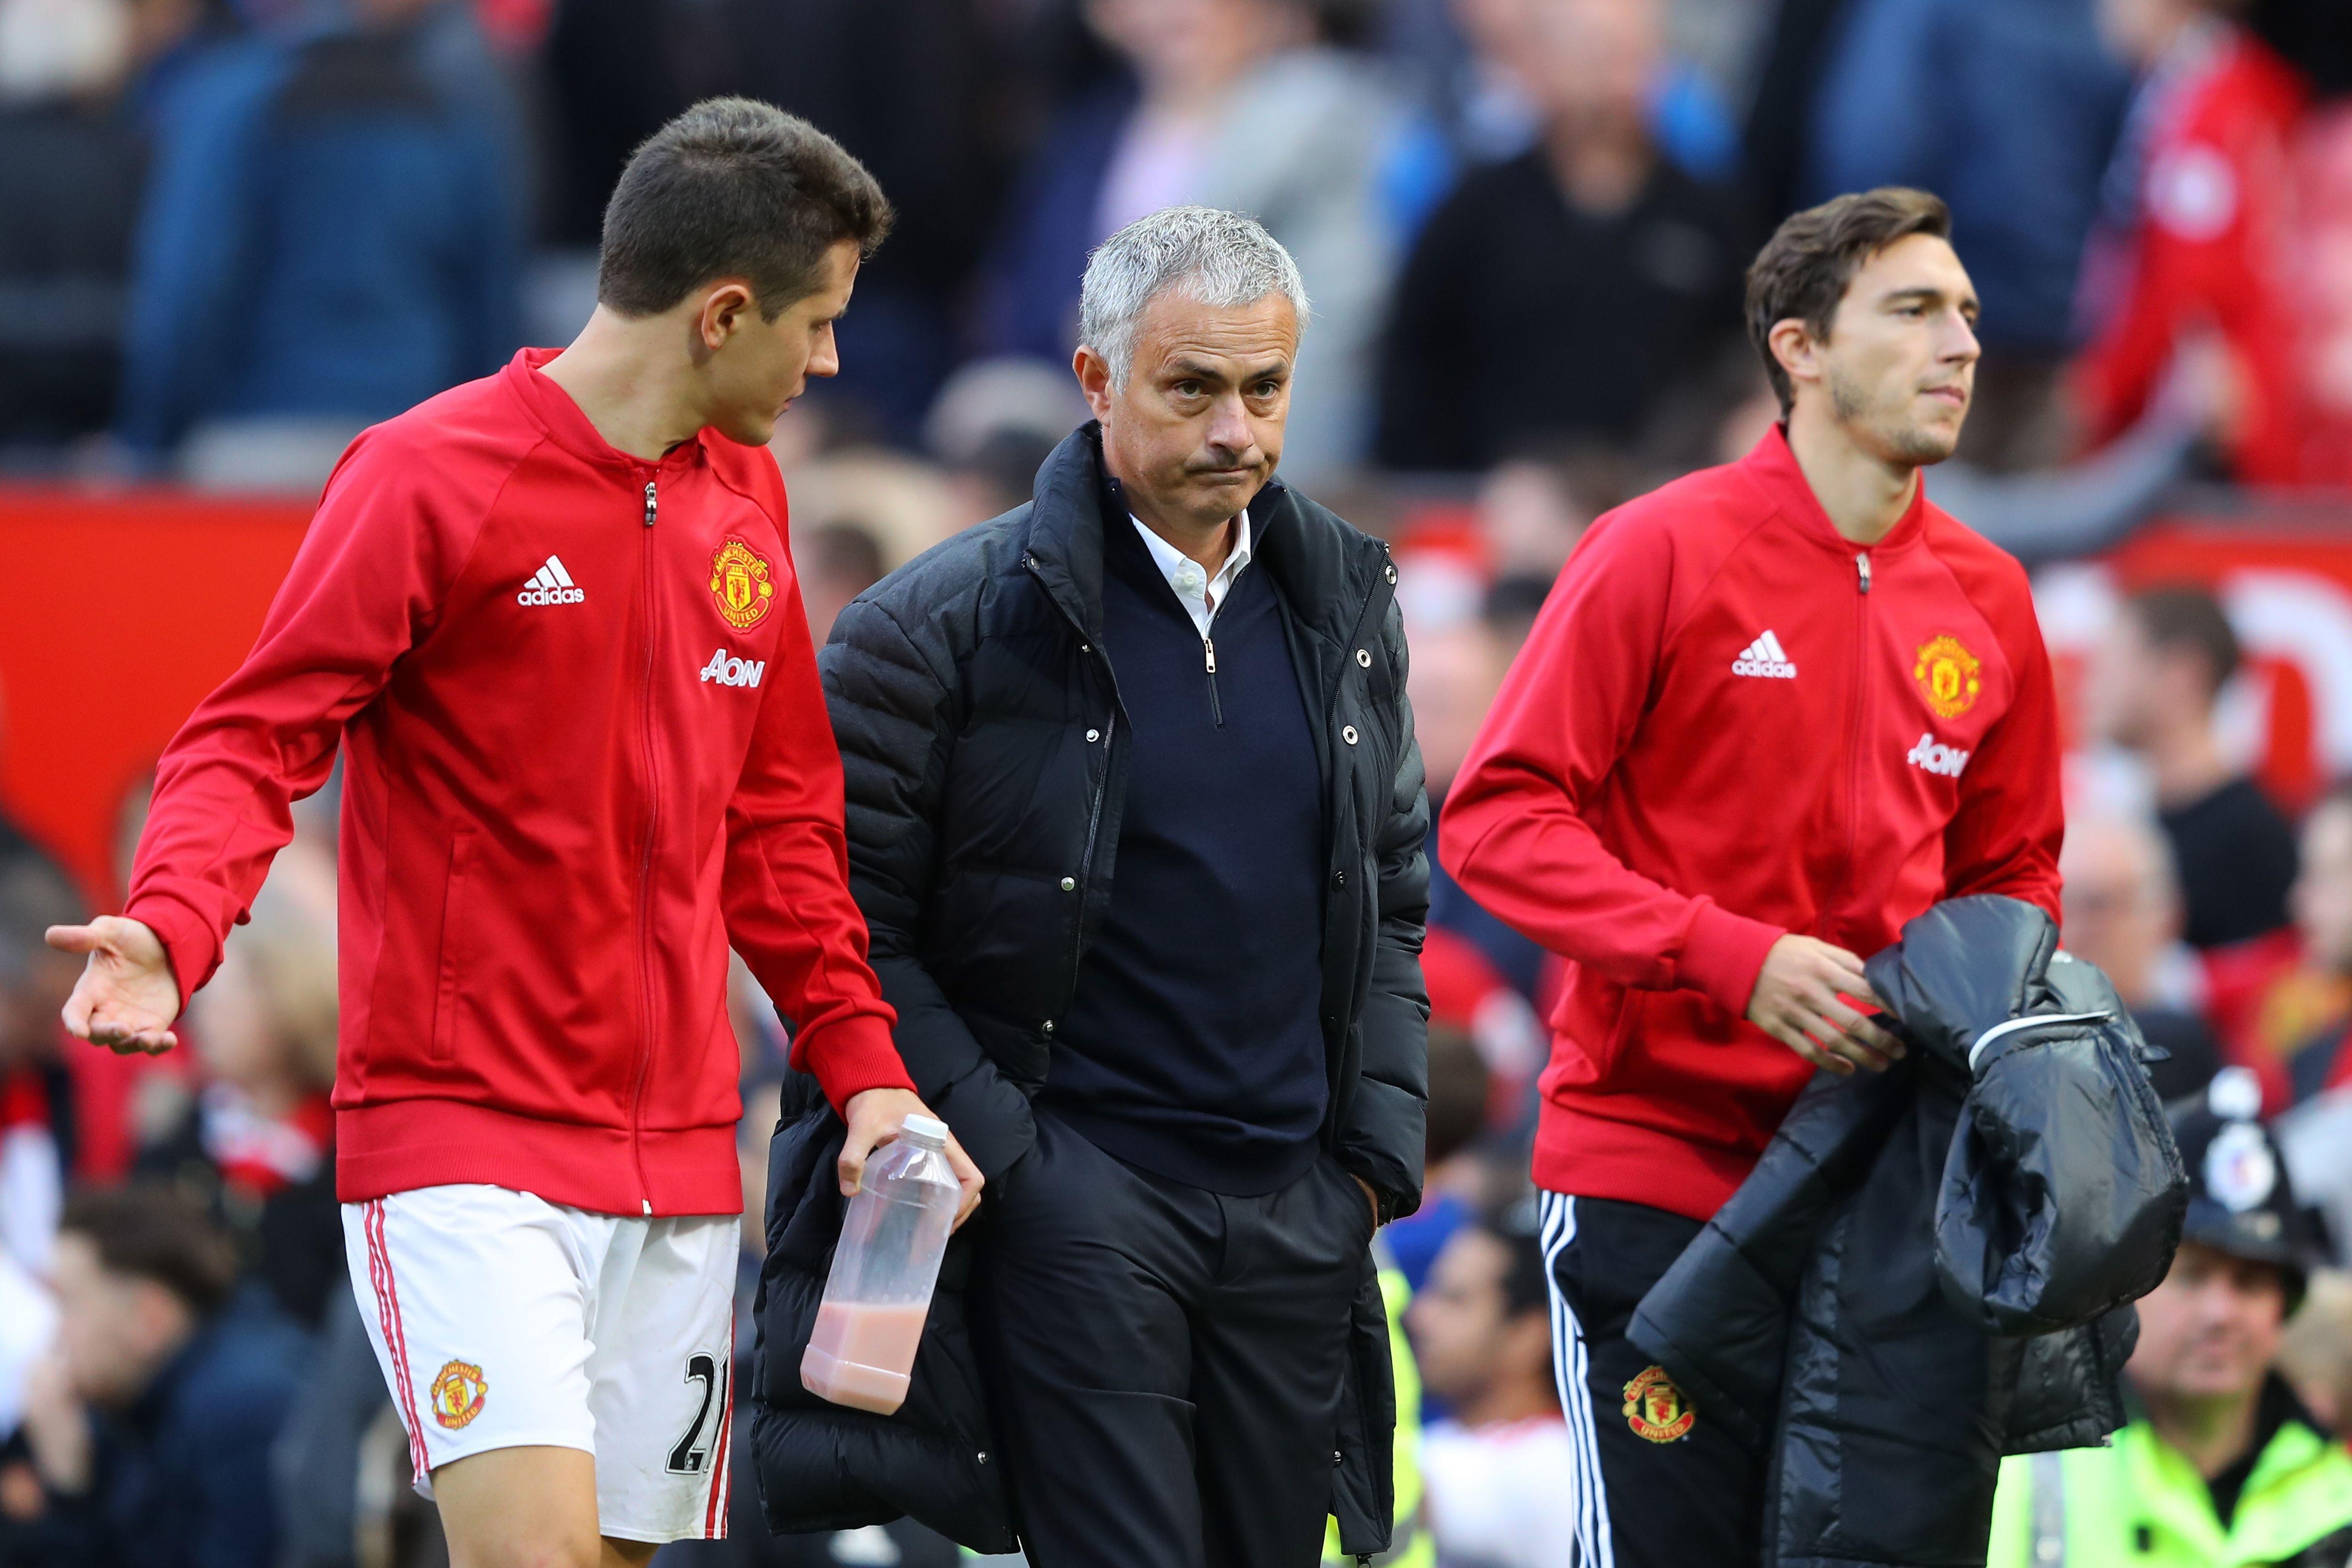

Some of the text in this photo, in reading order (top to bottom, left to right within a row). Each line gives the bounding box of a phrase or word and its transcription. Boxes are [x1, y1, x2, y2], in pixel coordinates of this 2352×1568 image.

[715, 548, 762, 577] MANCHESTER
[517, 586, 585, 606] adidas
[723, 607, 759, 623] UNITED
[700, 648, 765, 688] AON
[1731, 659, 1797, 679] adidas
[1907, 732, 1969, 778] AON
[445, 1406, 478, 1424] UNITED
[1640, 1422, 1684, 1437] UNITED
